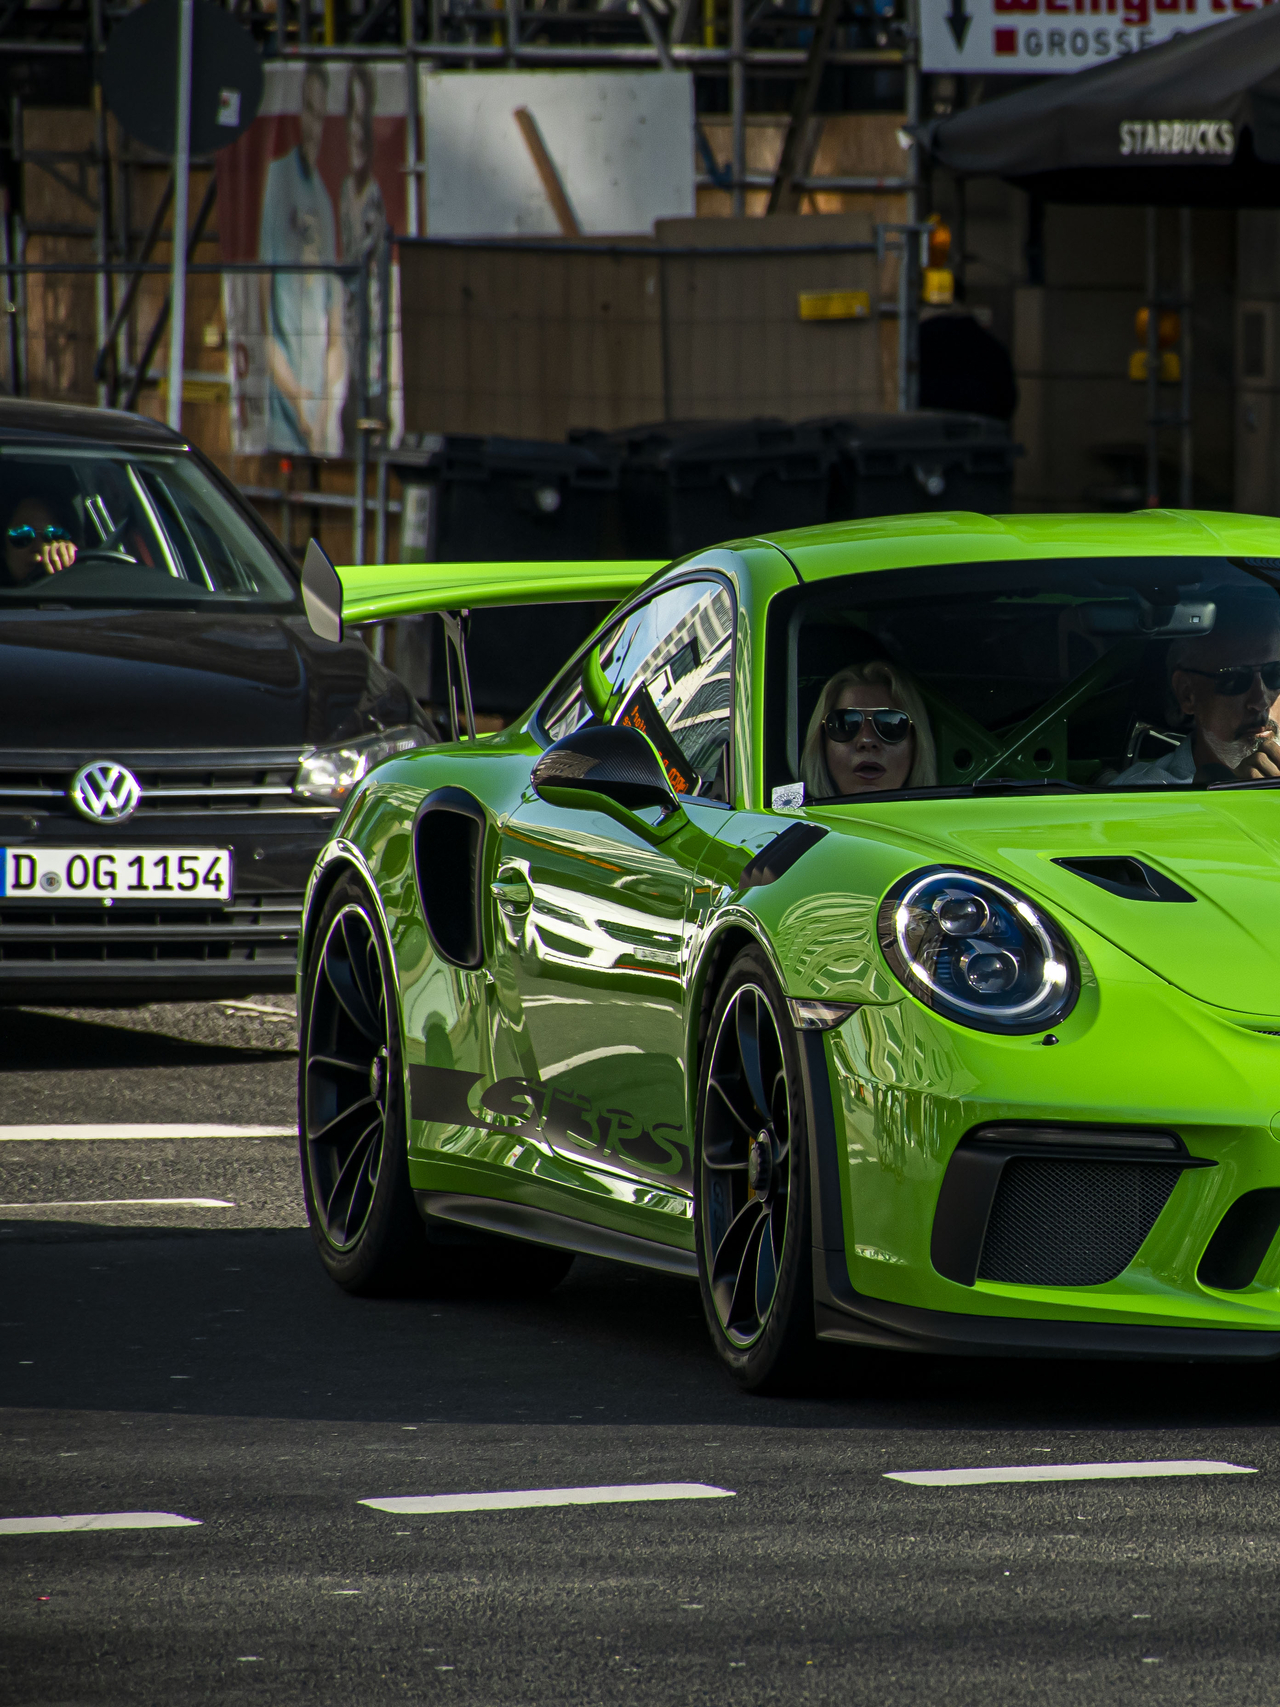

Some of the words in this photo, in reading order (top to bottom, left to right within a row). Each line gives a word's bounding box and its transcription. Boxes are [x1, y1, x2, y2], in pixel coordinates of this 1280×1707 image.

[1120, 120, 1235, 155] STARBUCKS
[11, 854, 38, 891] D
[65, 854, 118, 891] OG
[126, 855, 225, 892] 1154
